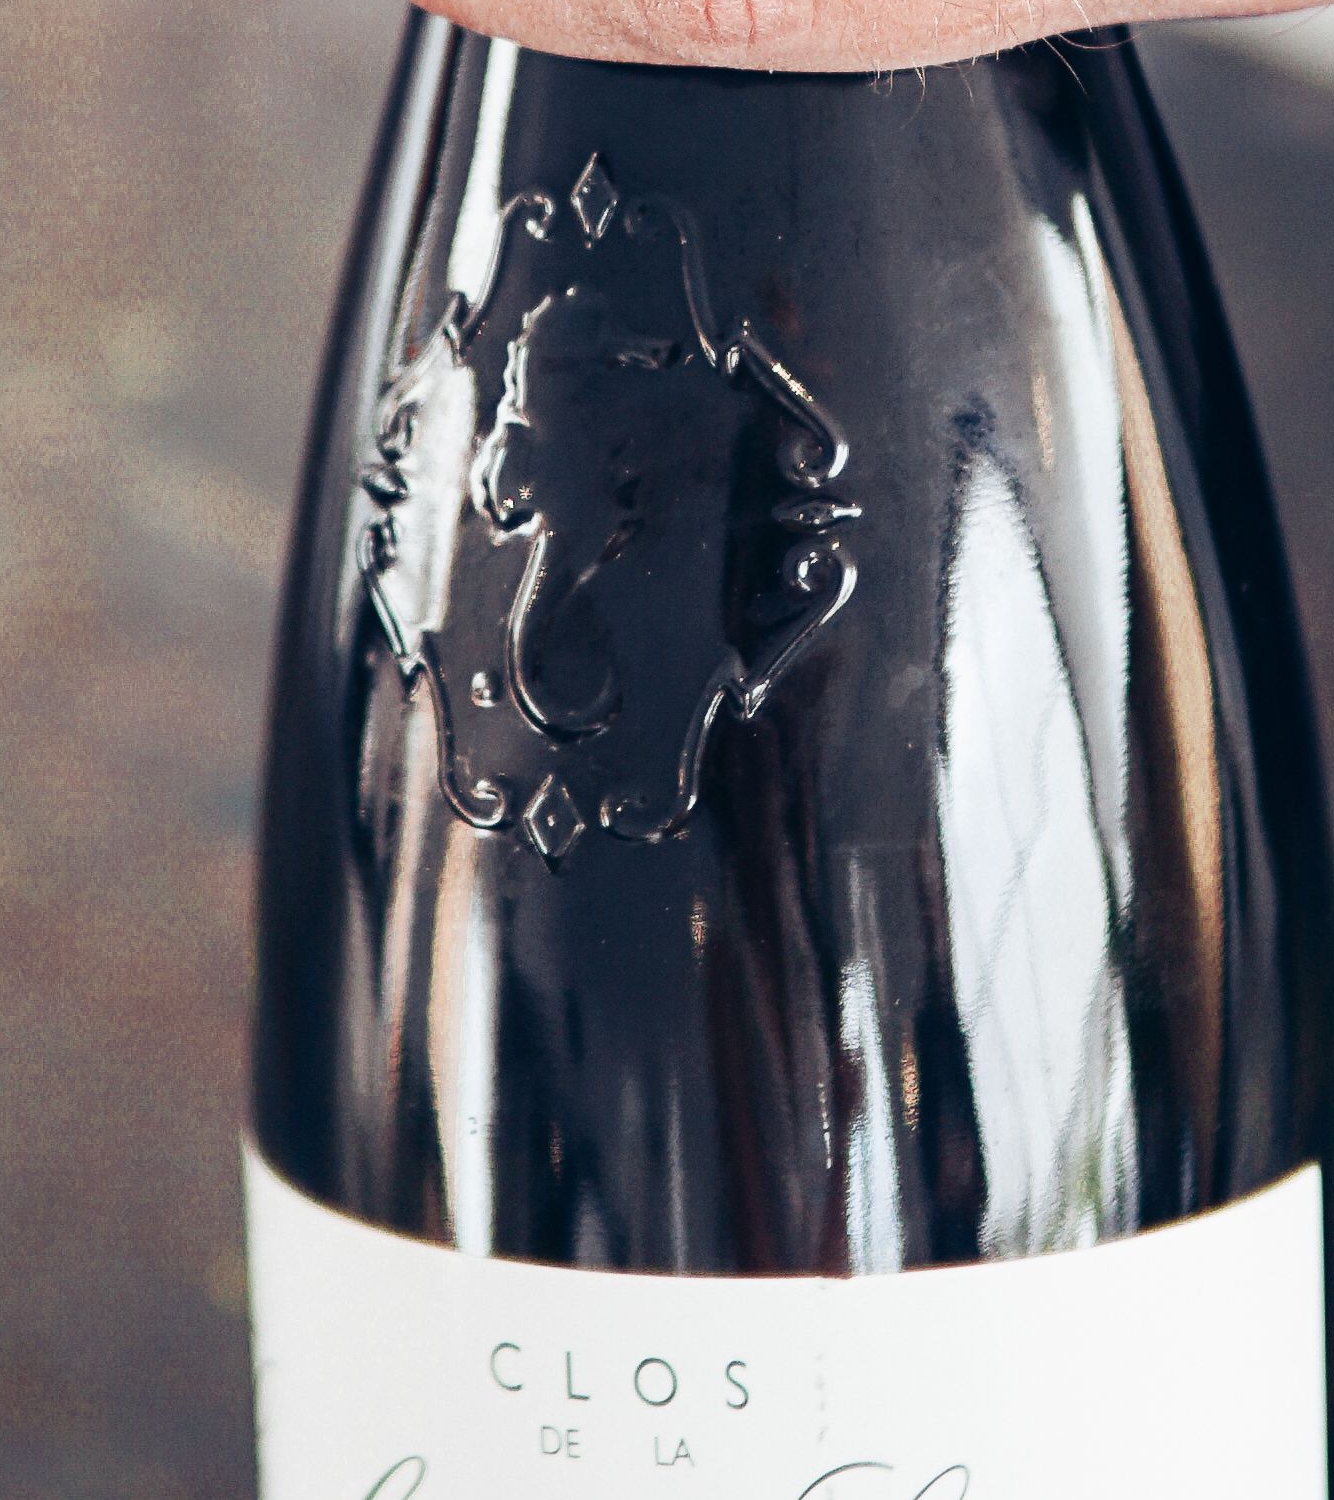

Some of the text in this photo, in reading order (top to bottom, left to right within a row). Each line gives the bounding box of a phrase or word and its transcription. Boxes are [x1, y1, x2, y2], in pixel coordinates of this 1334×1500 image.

[489, 1340, 751, 1411] CLOS
[539, 1425, 696, 1468] DE LA
